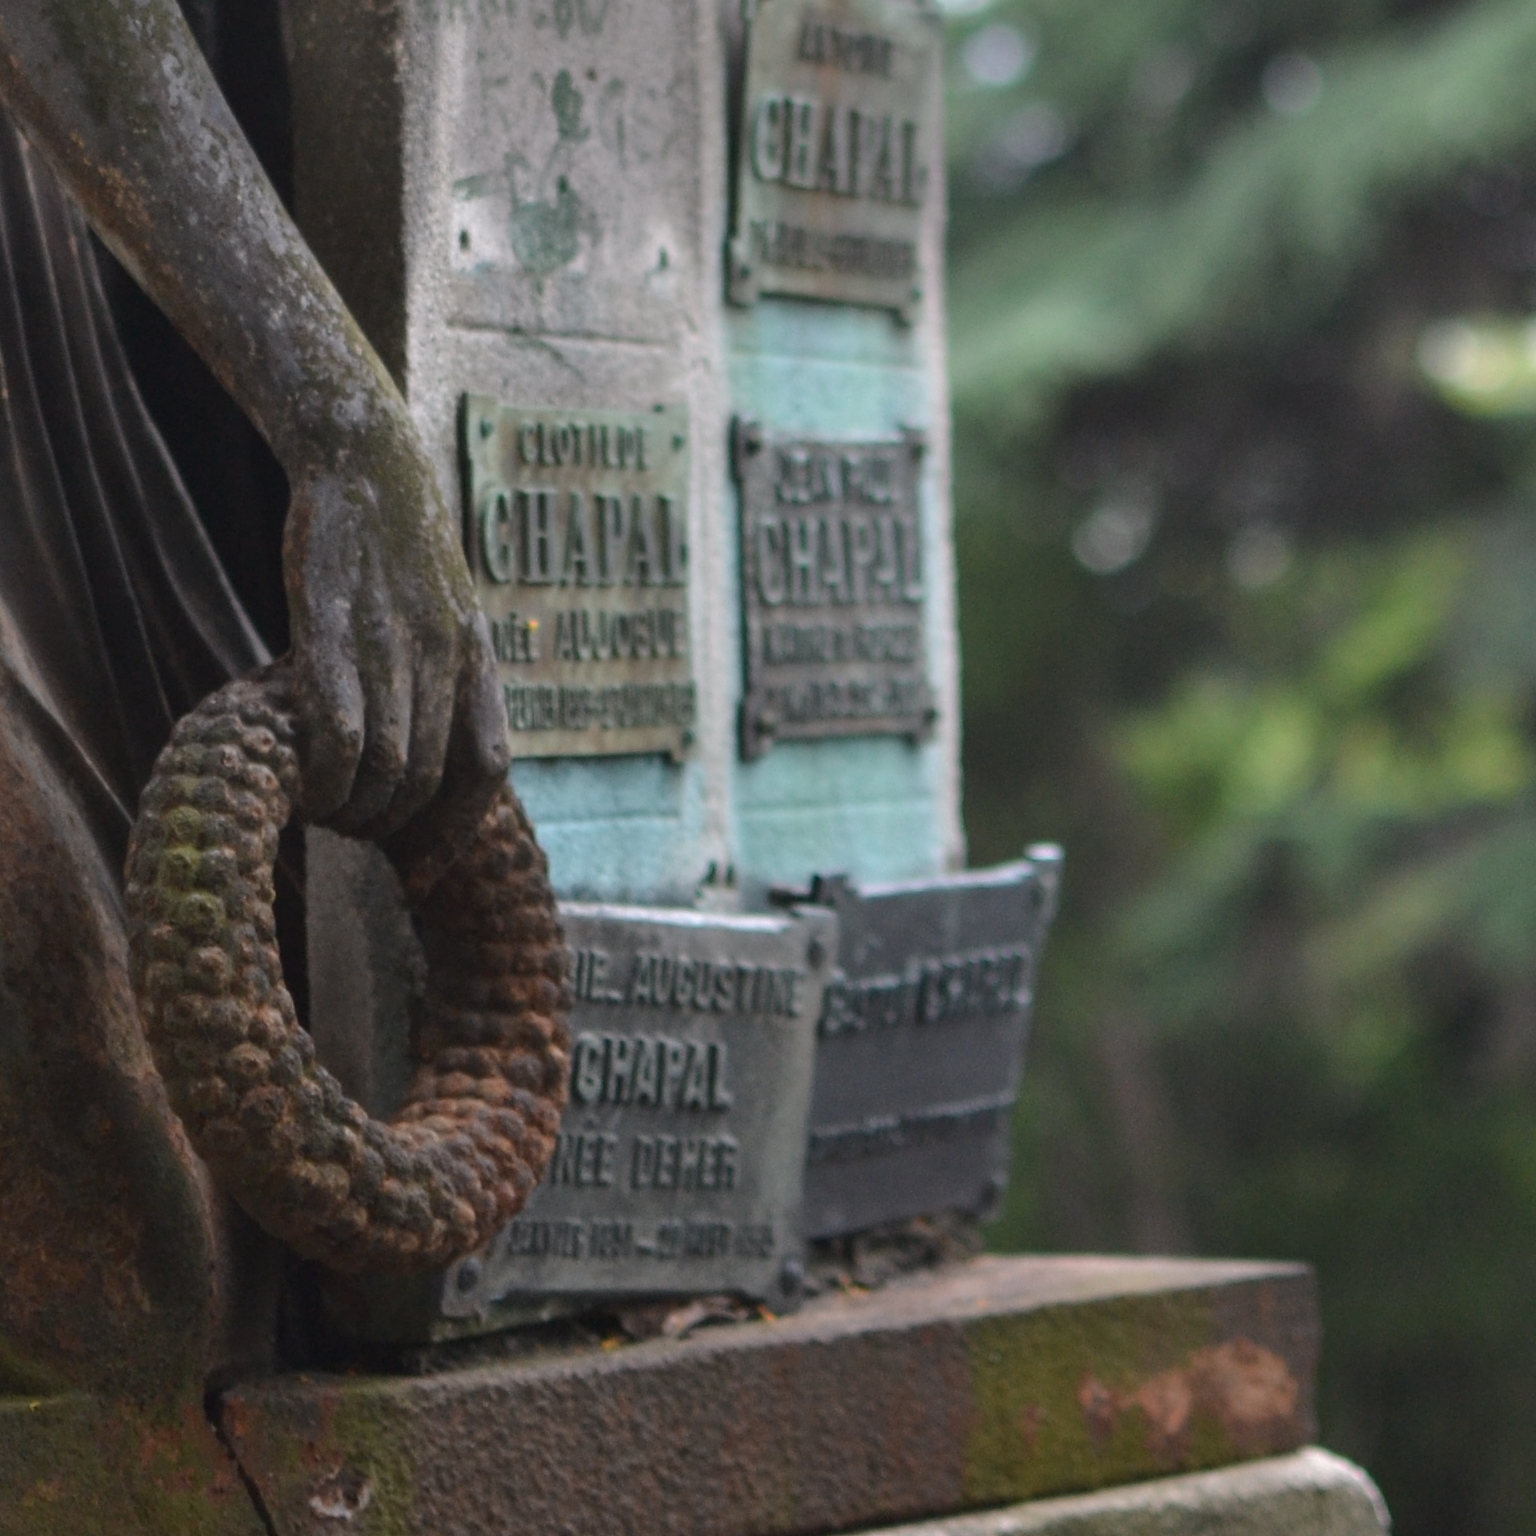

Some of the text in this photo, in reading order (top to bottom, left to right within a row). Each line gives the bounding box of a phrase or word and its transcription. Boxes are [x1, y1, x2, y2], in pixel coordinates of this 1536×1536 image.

[480, 486, 690, 588] CHAPAL
[758, 514, 924, 606] CHAPAL
[570, 1030, 732, 1111] CHAPAL
